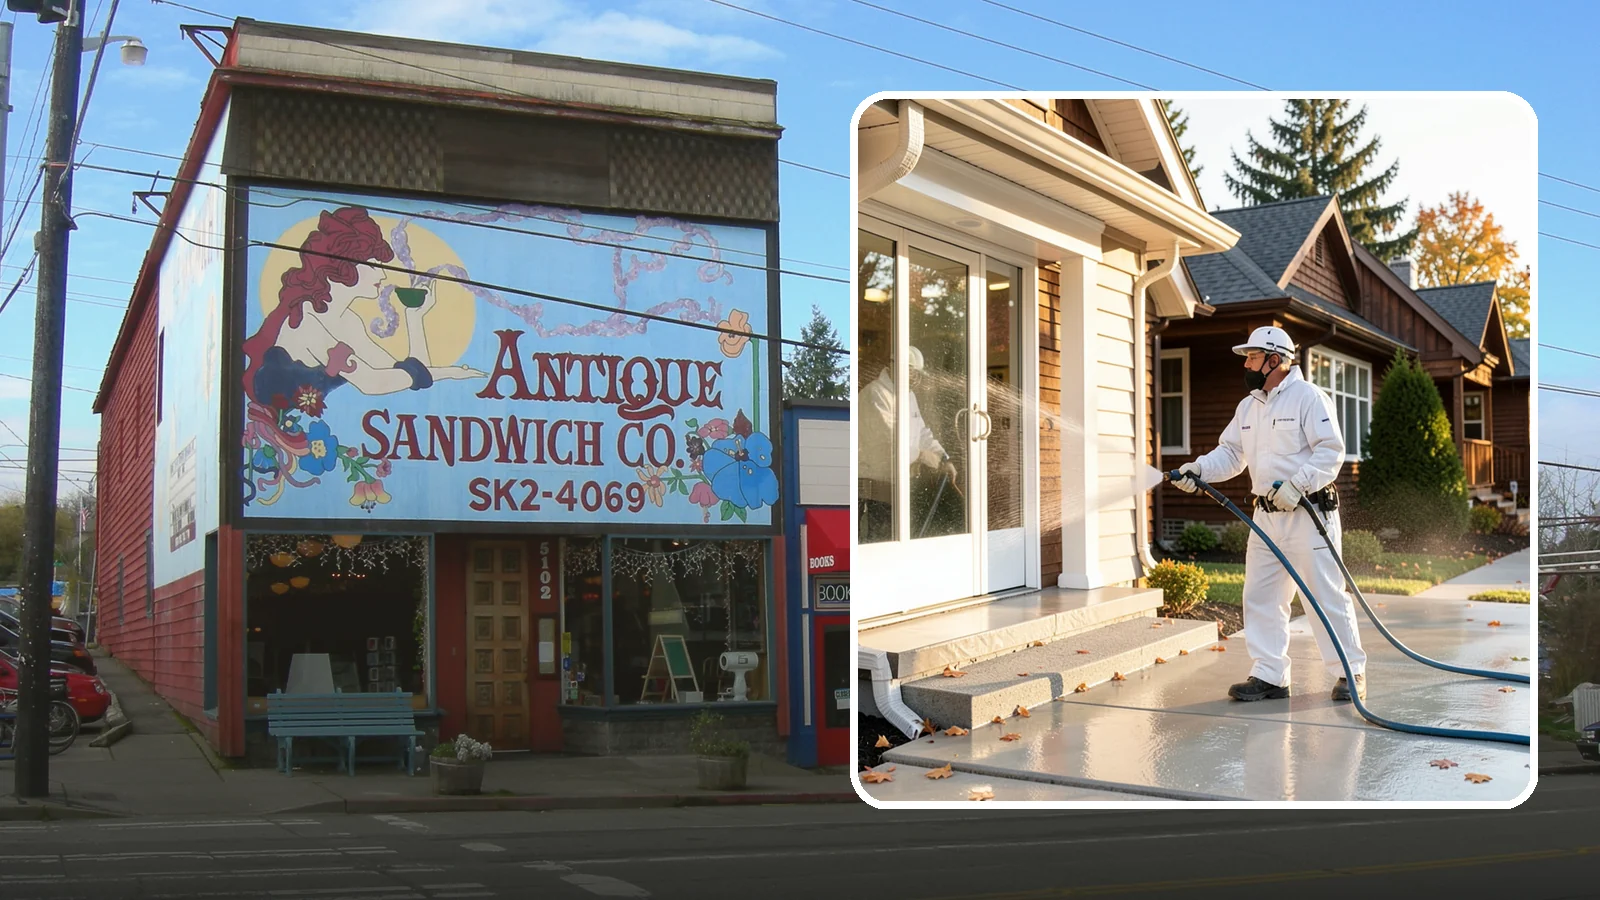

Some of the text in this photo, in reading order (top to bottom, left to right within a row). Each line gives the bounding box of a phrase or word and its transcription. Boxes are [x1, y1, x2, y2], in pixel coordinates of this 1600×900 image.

[476, 329, 723, 421] ANTIQUE
[361, 408, 685, 469] SANDWICH CO.
[469, 477, 645, 513] SK2-4069
[540, 542, 552, 599] 5102
[809, 555, 835, 569] BOOKS
